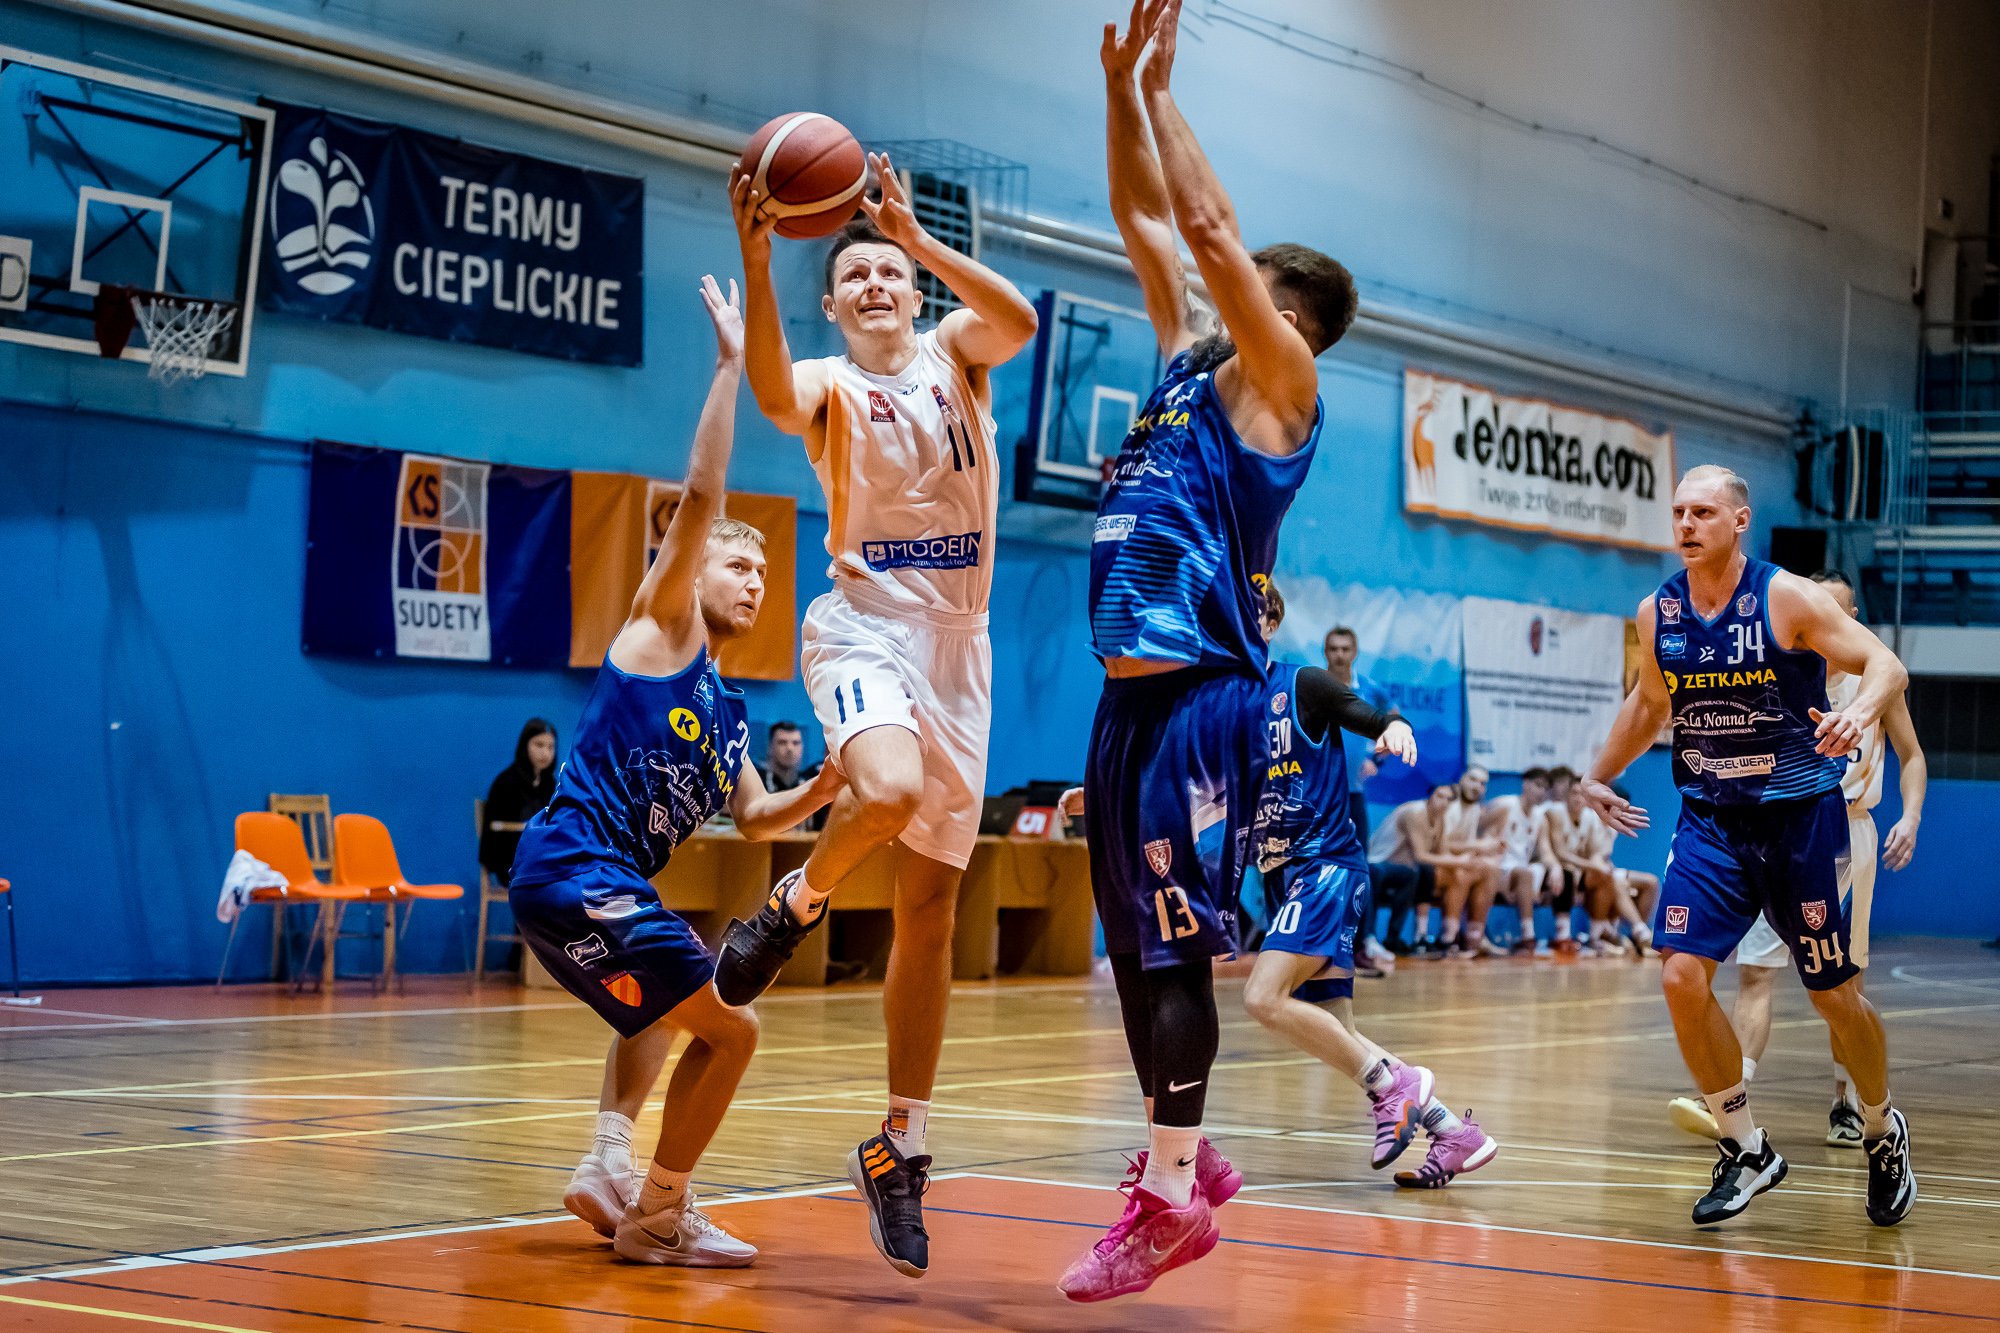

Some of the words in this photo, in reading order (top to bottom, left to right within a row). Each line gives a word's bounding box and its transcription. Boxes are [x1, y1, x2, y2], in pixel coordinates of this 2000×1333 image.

[440, 175, 582, 251] TERMY
[393, 242, 622, 330] CIEPLICKIE
[947, 418, 976, 472] 11
[1454, 395, 1656, 501] Jelonka.com
[398, 599, 482, 631] SUDETY
[1727, 620, 1766, 665] 34
[834, 677, 865, 725] 11
[1682, 668, 1778, 690] ZETKAMA
[1268, 717, 1292, 760] 30
[1688, 711, 1702, 728] La
[1703, 711, 1747, 729] Nonna
[1154, 885, 1200, 943] 13
[1799, 930, 1845, 975] 34
